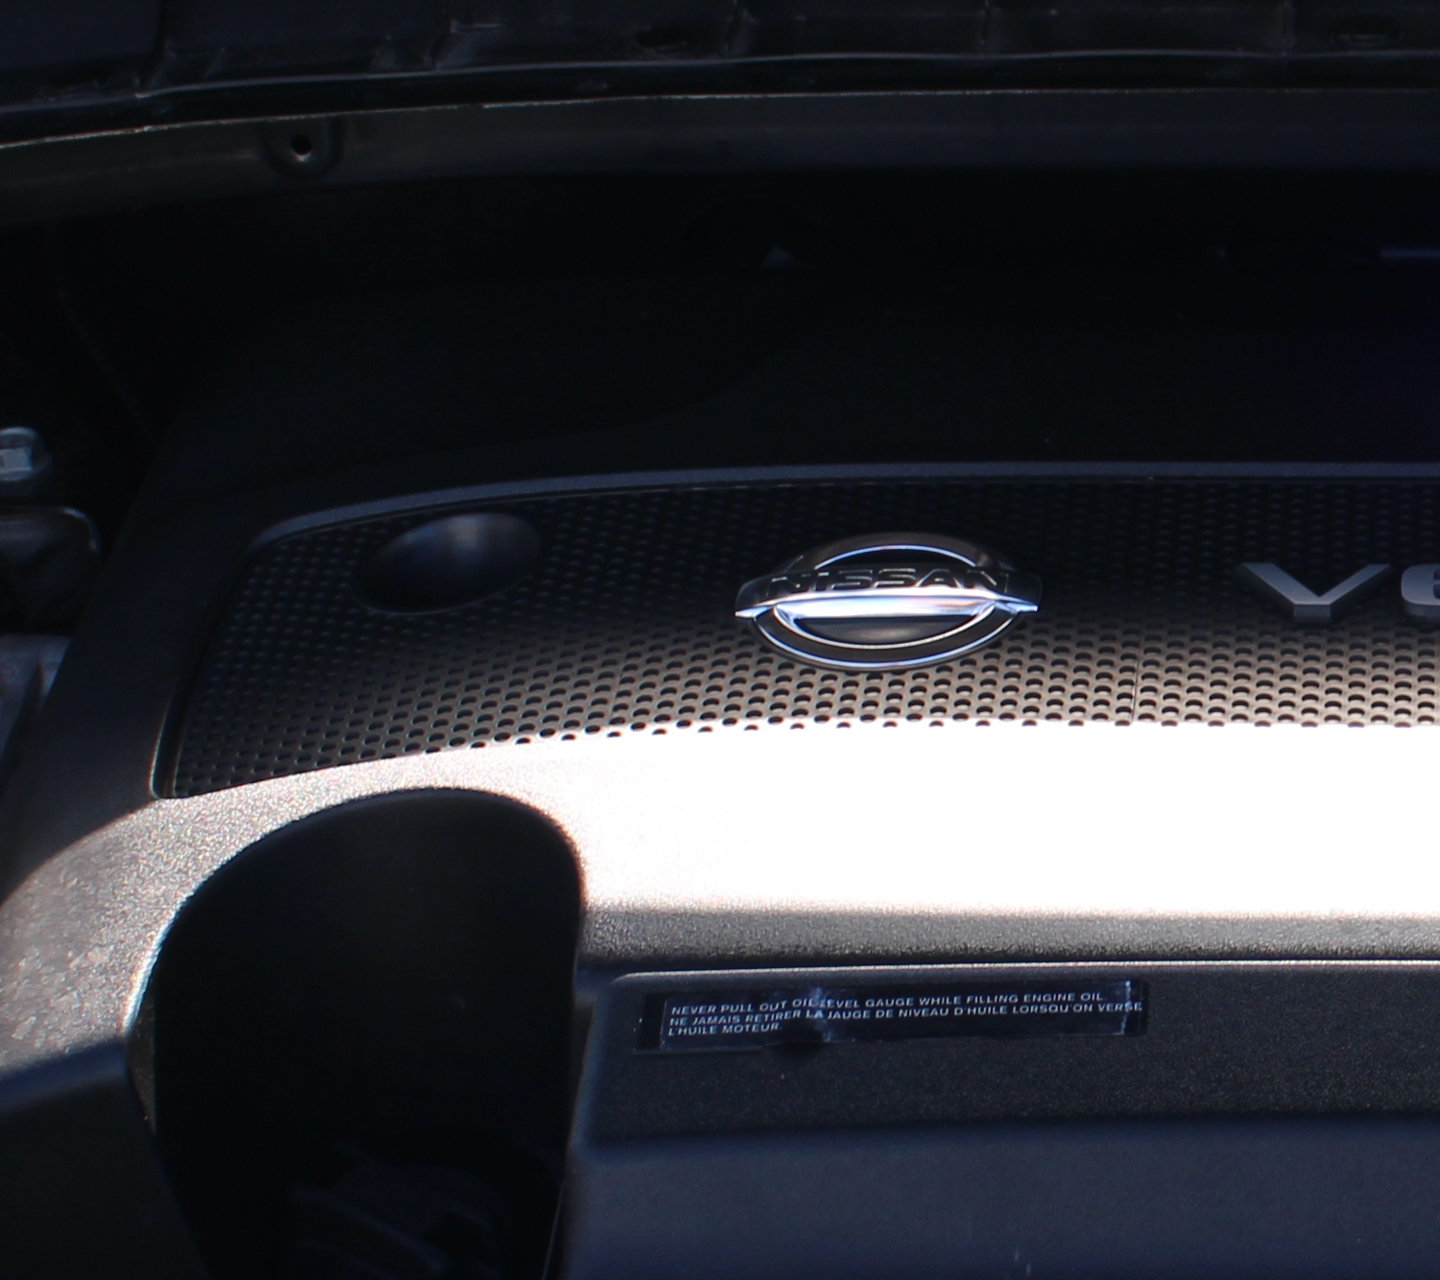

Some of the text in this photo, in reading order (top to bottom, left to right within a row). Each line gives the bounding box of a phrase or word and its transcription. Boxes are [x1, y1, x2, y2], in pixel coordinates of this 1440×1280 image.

[766, 568, 1010, 597] NISSAN
[669, 1001, 1143, 1027] NE JAMAIS RETIRER LA JAUGE DE NIVEAU D'HUILE LORSQU'ON VERSE
[671, 1005, 717, 1016] NEVER
[721, 1003, 754, 1013] PULL
[760, 1000, 786, 1011] OUT
[865, 997, 913, 1008] GAUGE
[919, 995, 962, 1006] WHILE
[966, 994, 1019, 1004] FILLING
[1023, 993, 1076, 1003] ENGINE
[668, 1025, 718, 1037] L'HUILE
